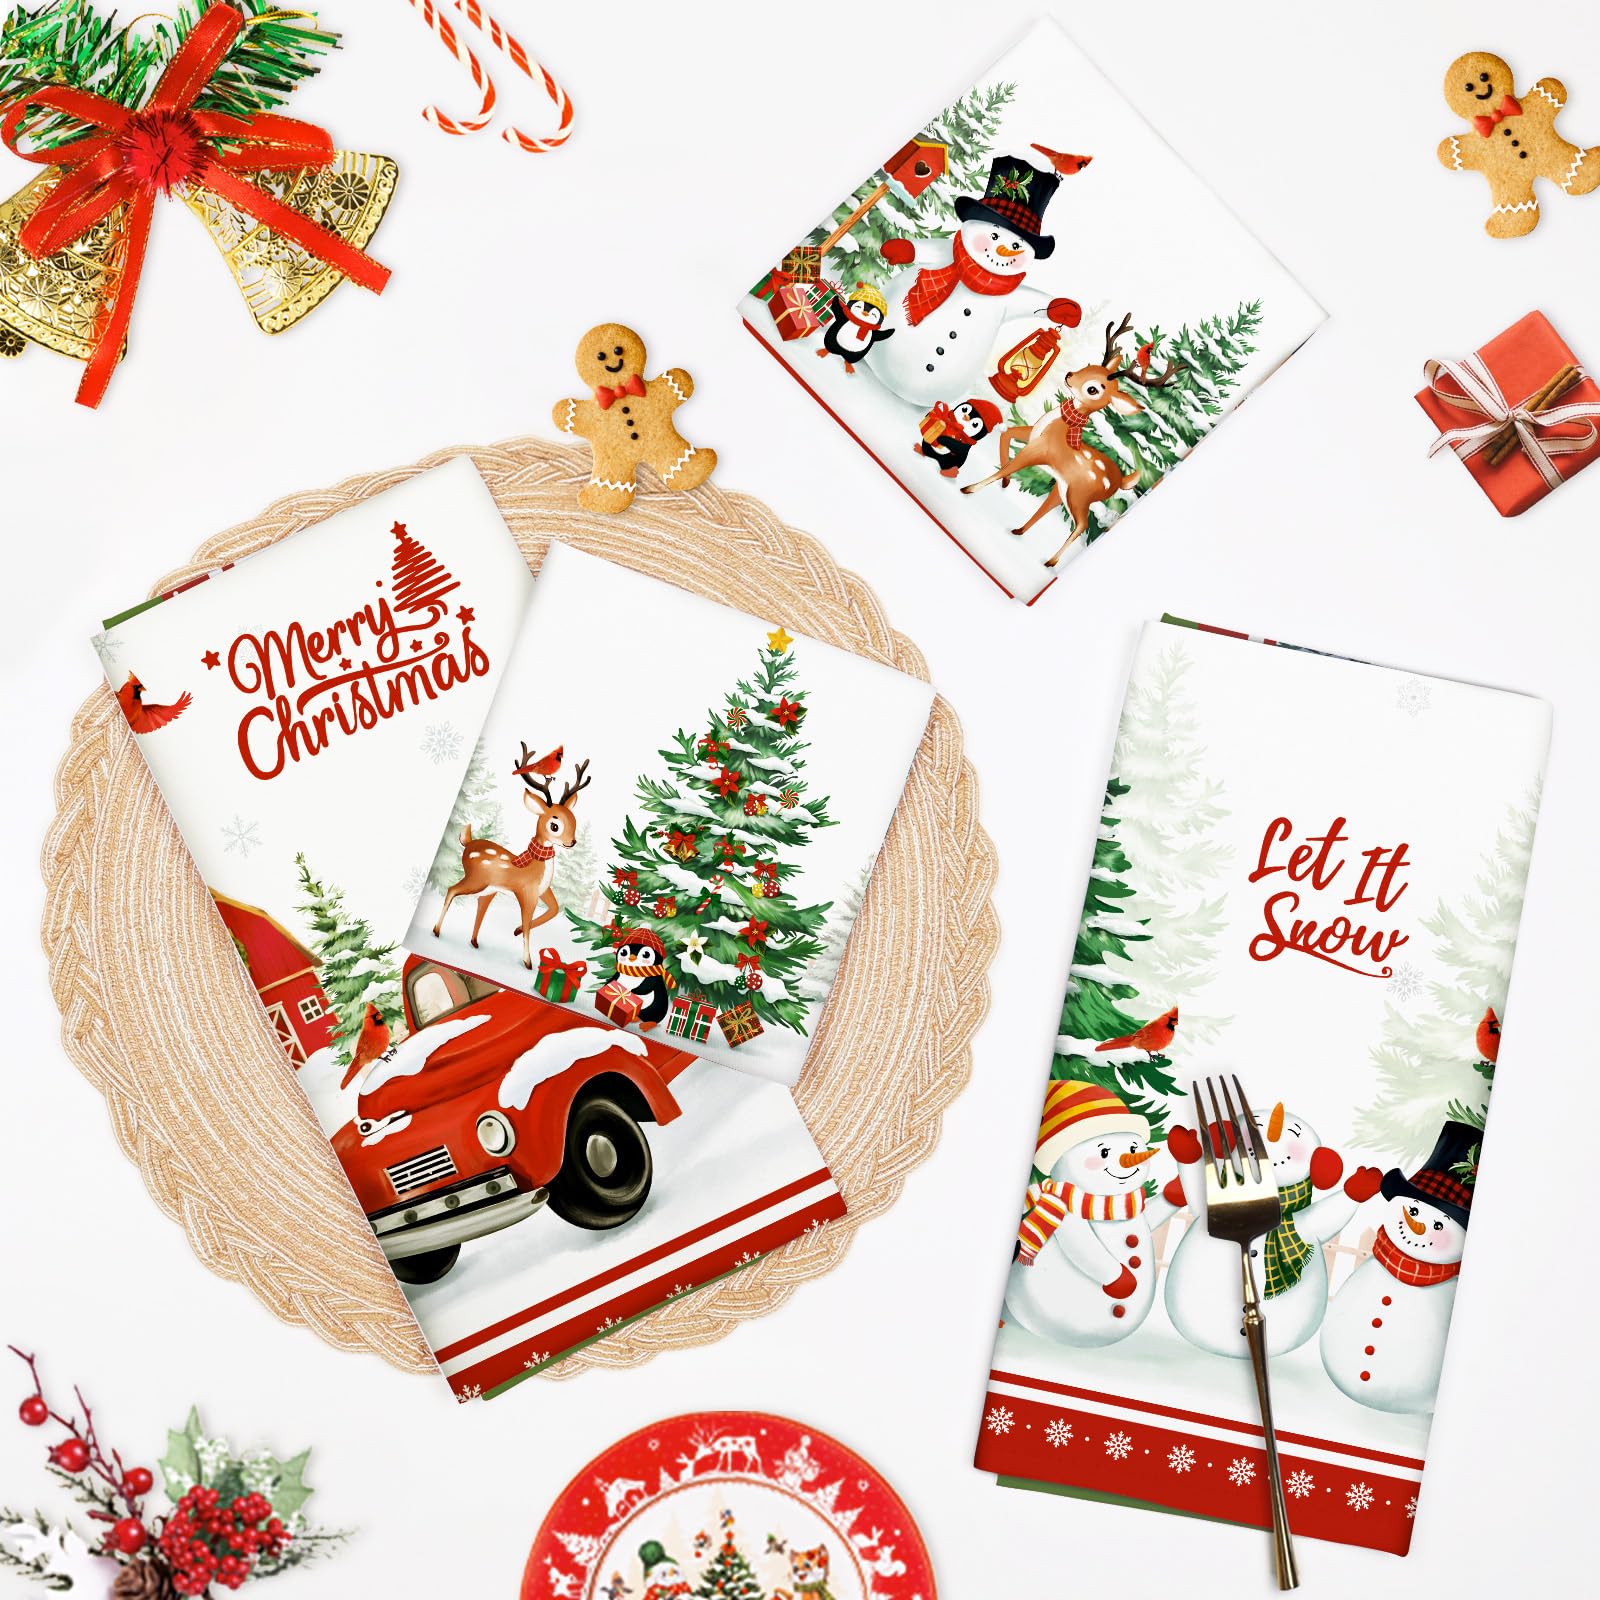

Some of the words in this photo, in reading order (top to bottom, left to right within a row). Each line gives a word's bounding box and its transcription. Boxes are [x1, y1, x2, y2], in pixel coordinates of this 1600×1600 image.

[228, 597, 441, 700] Merry
[238, 626, 490, 780] Christmas
[1248, 816, 1348, 890] Let
[1344, 843, 1410, 912] It
[1249, 891, 1409, 978] Snow
